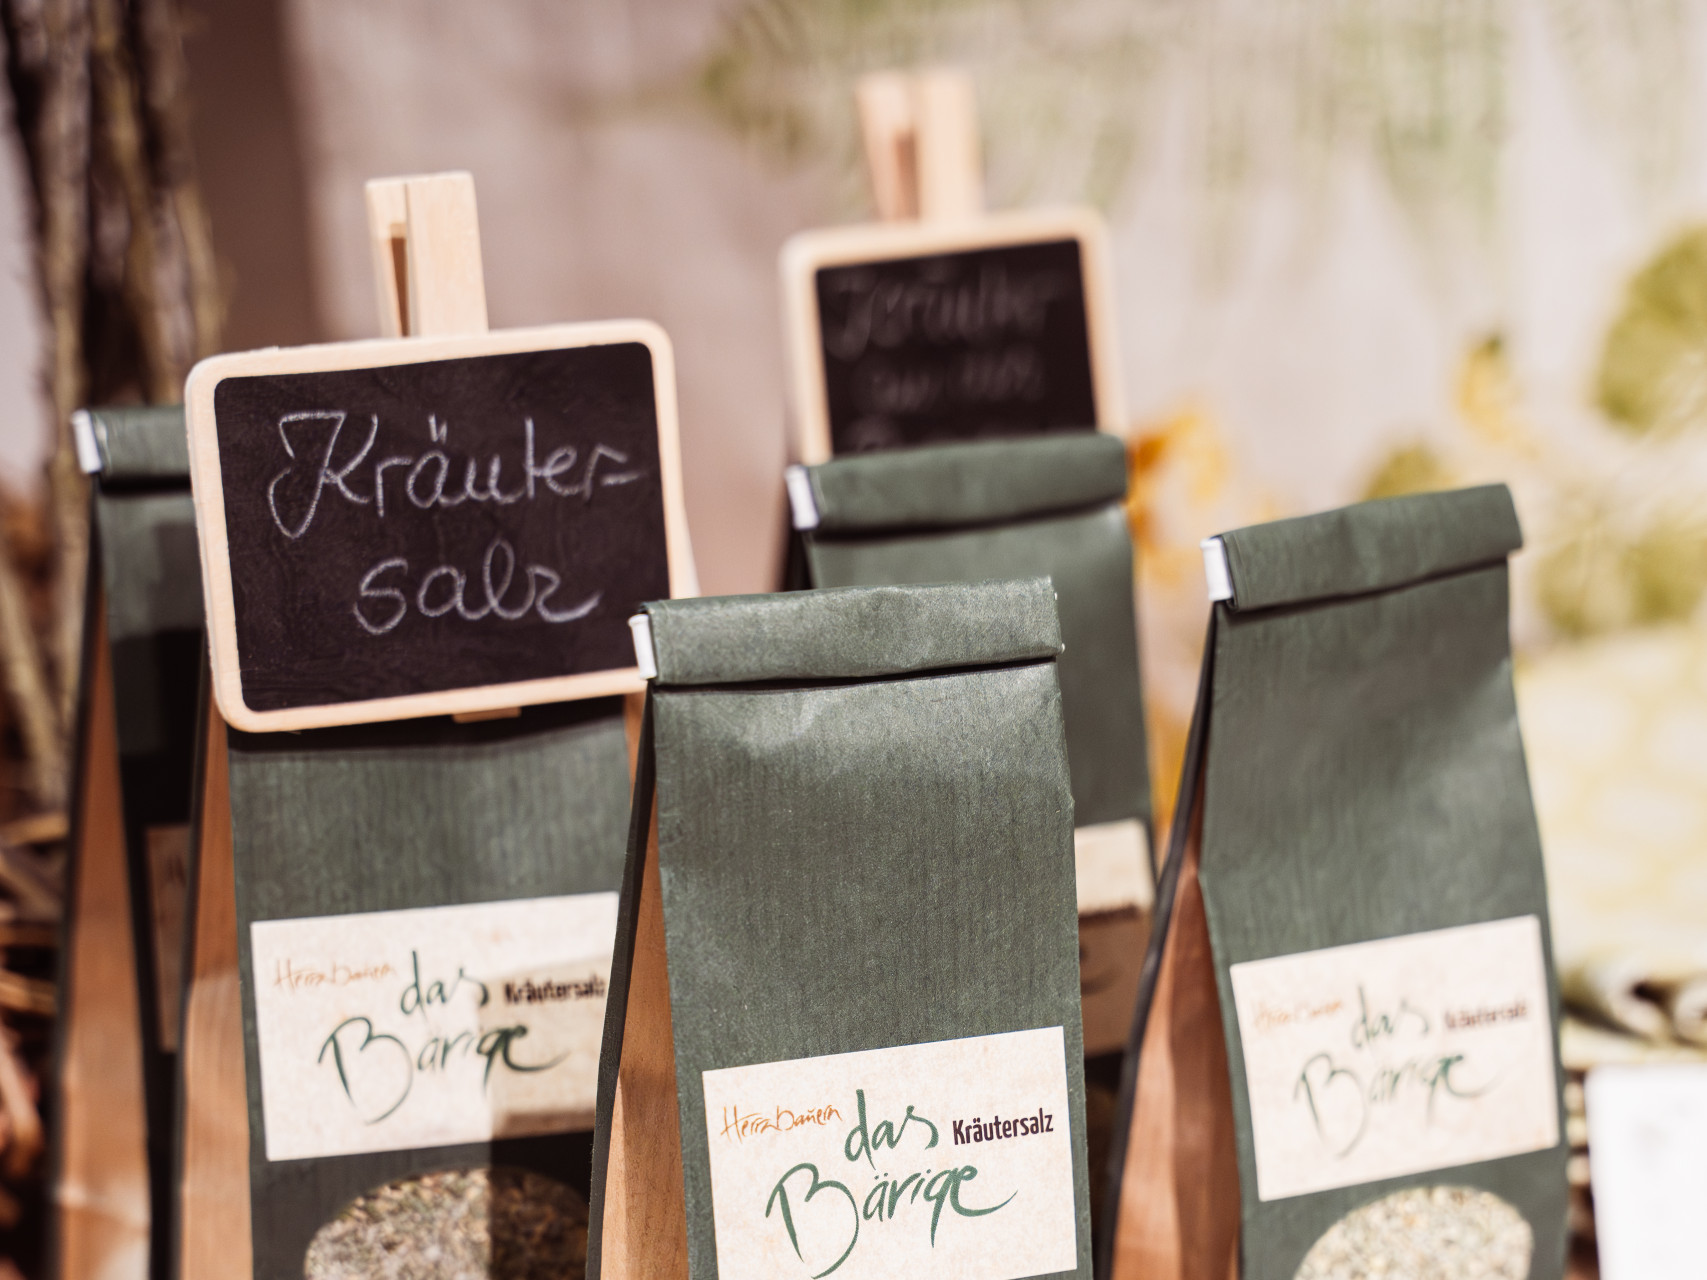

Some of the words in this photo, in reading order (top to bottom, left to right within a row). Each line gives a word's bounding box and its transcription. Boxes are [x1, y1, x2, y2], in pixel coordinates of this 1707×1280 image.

[268, 411, 646, 539] Kräuter-
[353, 539, 603, 636] salz
[400, 948, 492, 1020] das
[844, 1088, 940, 1171] das
[952, 1107, 1055, 1146] Kräutersalz
[764, 1162, 1019, 1280] Bärige
